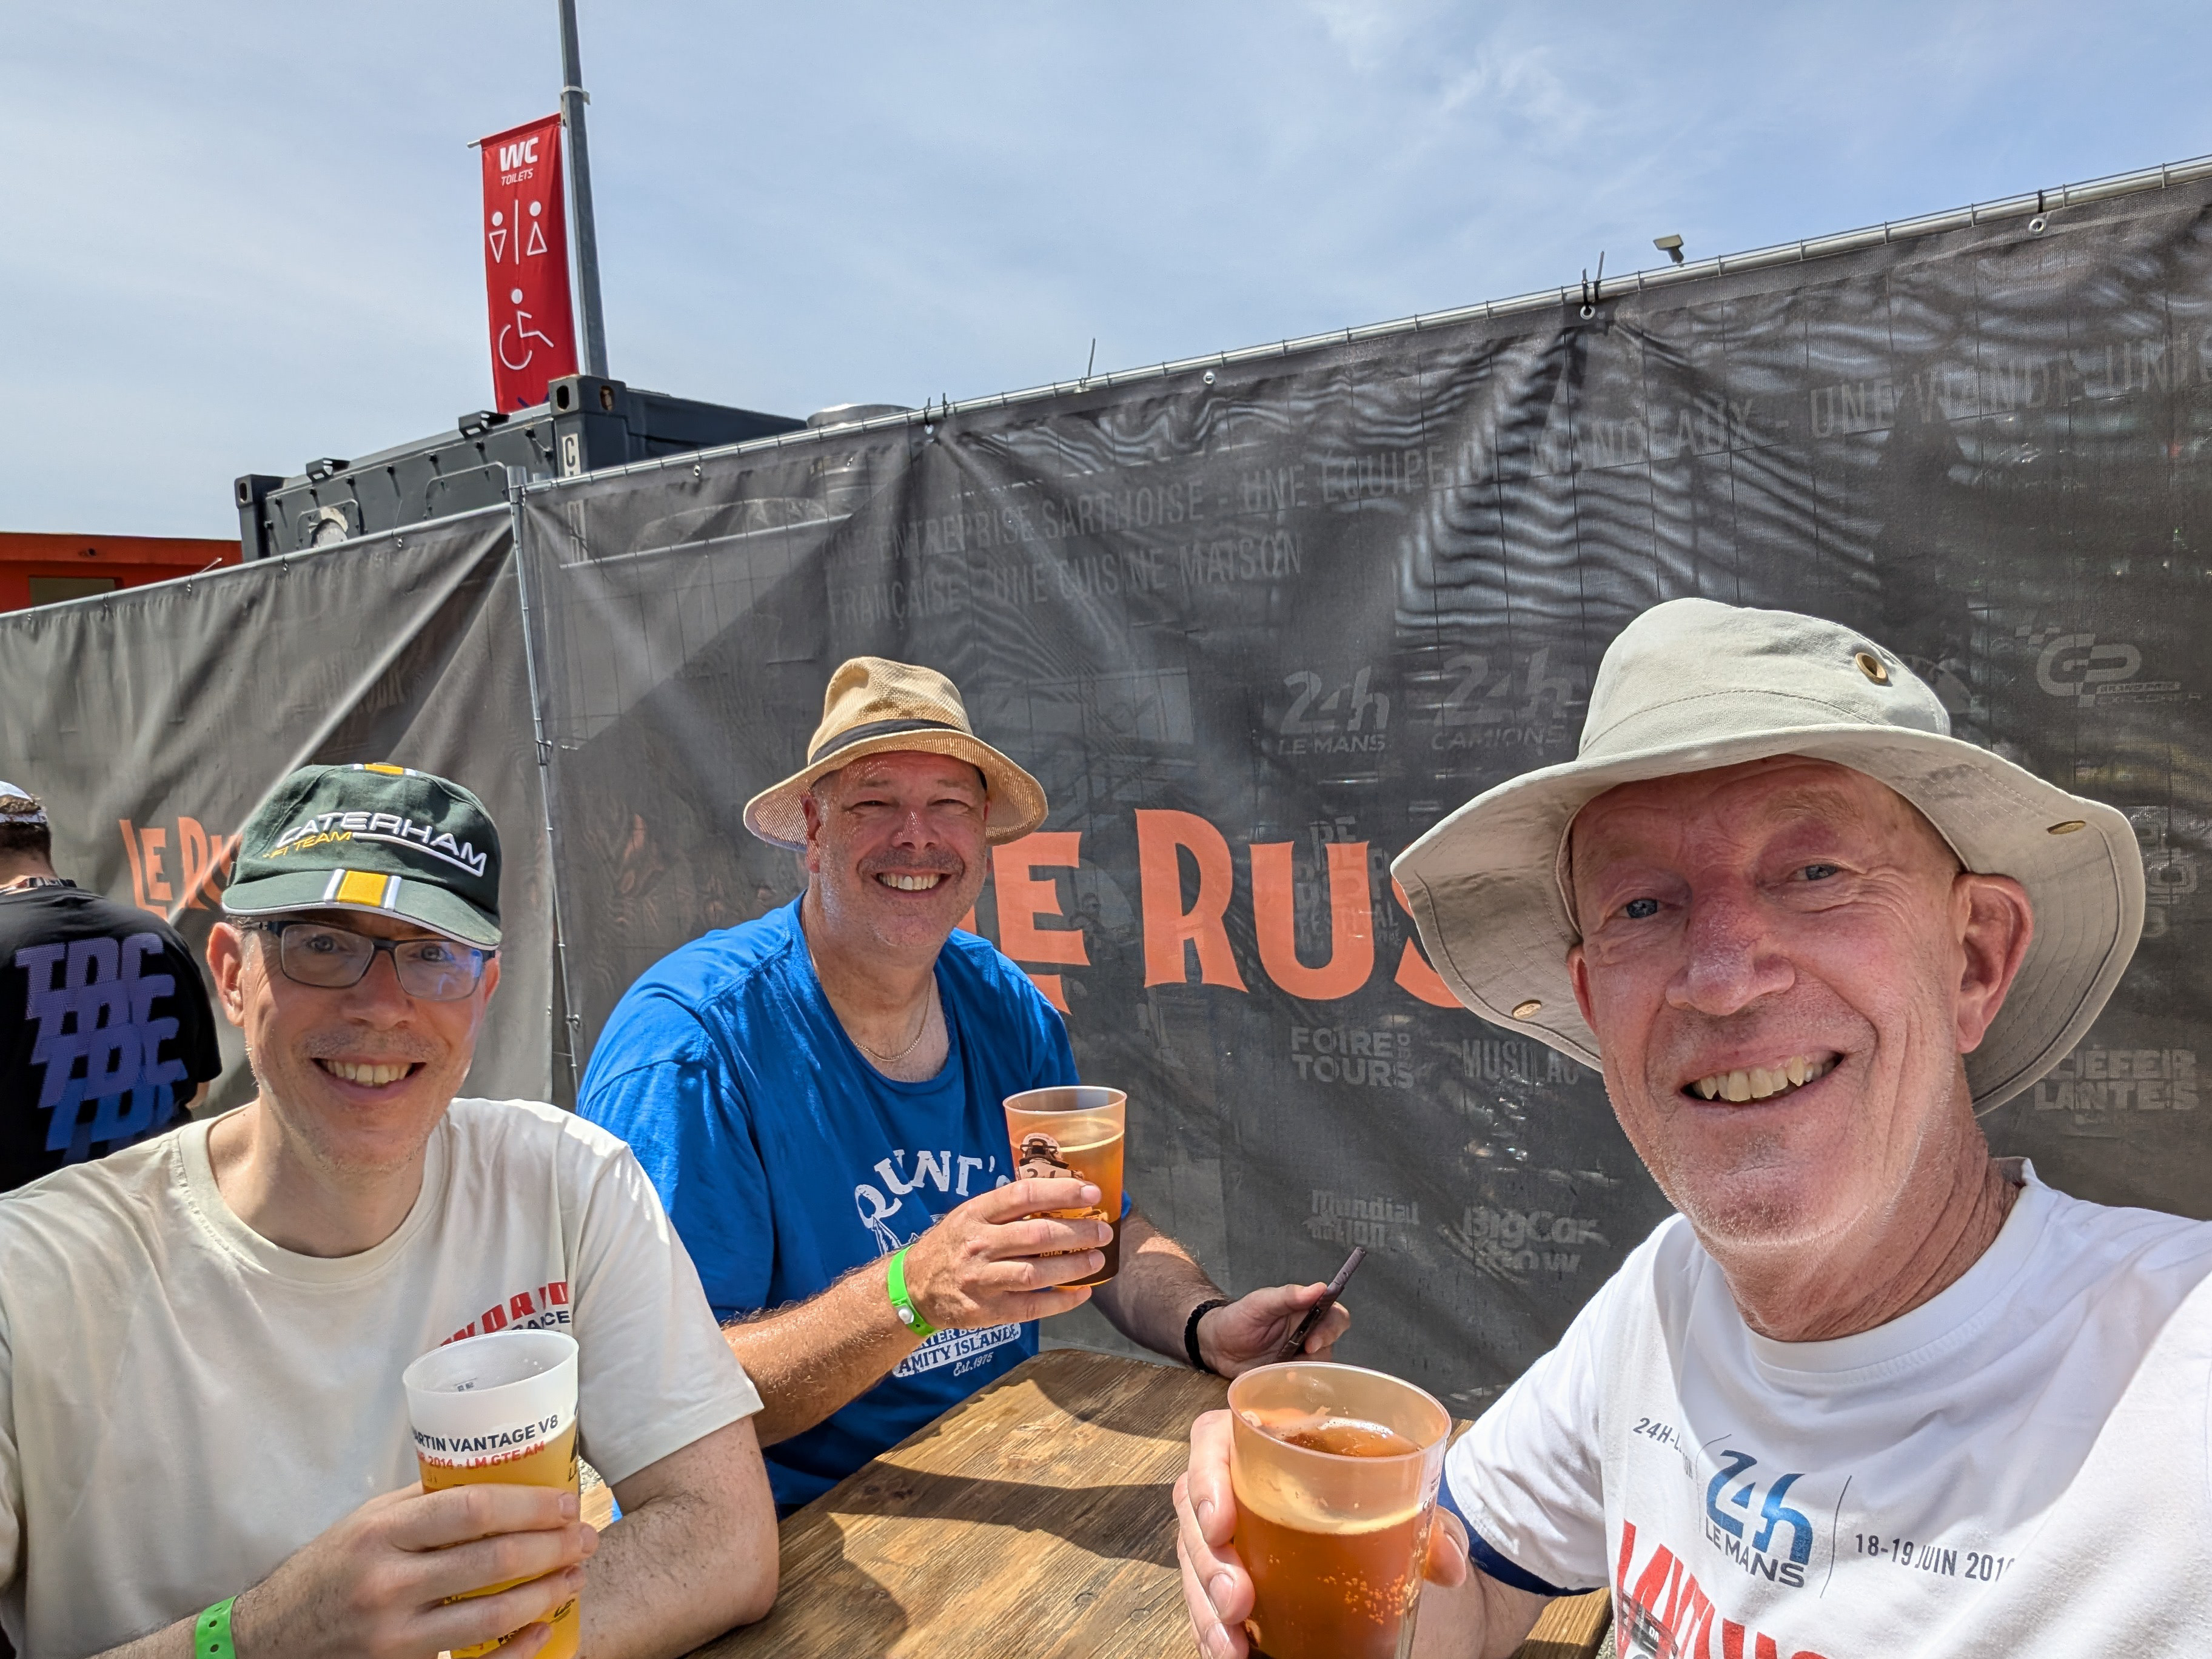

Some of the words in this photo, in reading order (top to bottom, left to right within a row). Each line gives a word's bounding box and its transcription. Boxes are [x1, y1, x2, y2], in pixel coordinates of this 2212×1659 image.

[500, 137, 538, 172] WC
[501, 168, 534, 186] TOILETS
[1811, 377, 1892, 439] UNE
[1041, 480, 1204, 540] SARTHOISE
[1243, 463, 1305, 513] UNE
[827, 576, 961, 631] FRANÇAISE
[993, 561, 1048, 605] UNE
[1278, 738, 1307, 756] LE
[1313, 734, 1387, 753] MANS
[1431, 725, 1566, 751] CAMIONS
[276, 811, 487, 867] CATERHAM
[293, 831, 353, 850] TEAM
[119, 819, 173, 922] LE
[1291, 1027, 1394, 1057] FOIRE
[1292, 1054, 1415, 1090] TOURS
[898, 1345, 951, 1375] AMITY
[449, 1423, 535, 1452] VANTAGE
[538, 1414, 558, 1433] V8
[466, 1456, 487, 1470] LM
[491, 1449, 521, 1467] GTE
[523, 1440, 545, 1458] AM
[1705, 1517, 1721, 1551] LE
[1725, 1533, 1805, 1589] MANS
[1855, 1533, 1914, 1566] 18-19
[1914, 1544, 1957, 1576] JUIN
